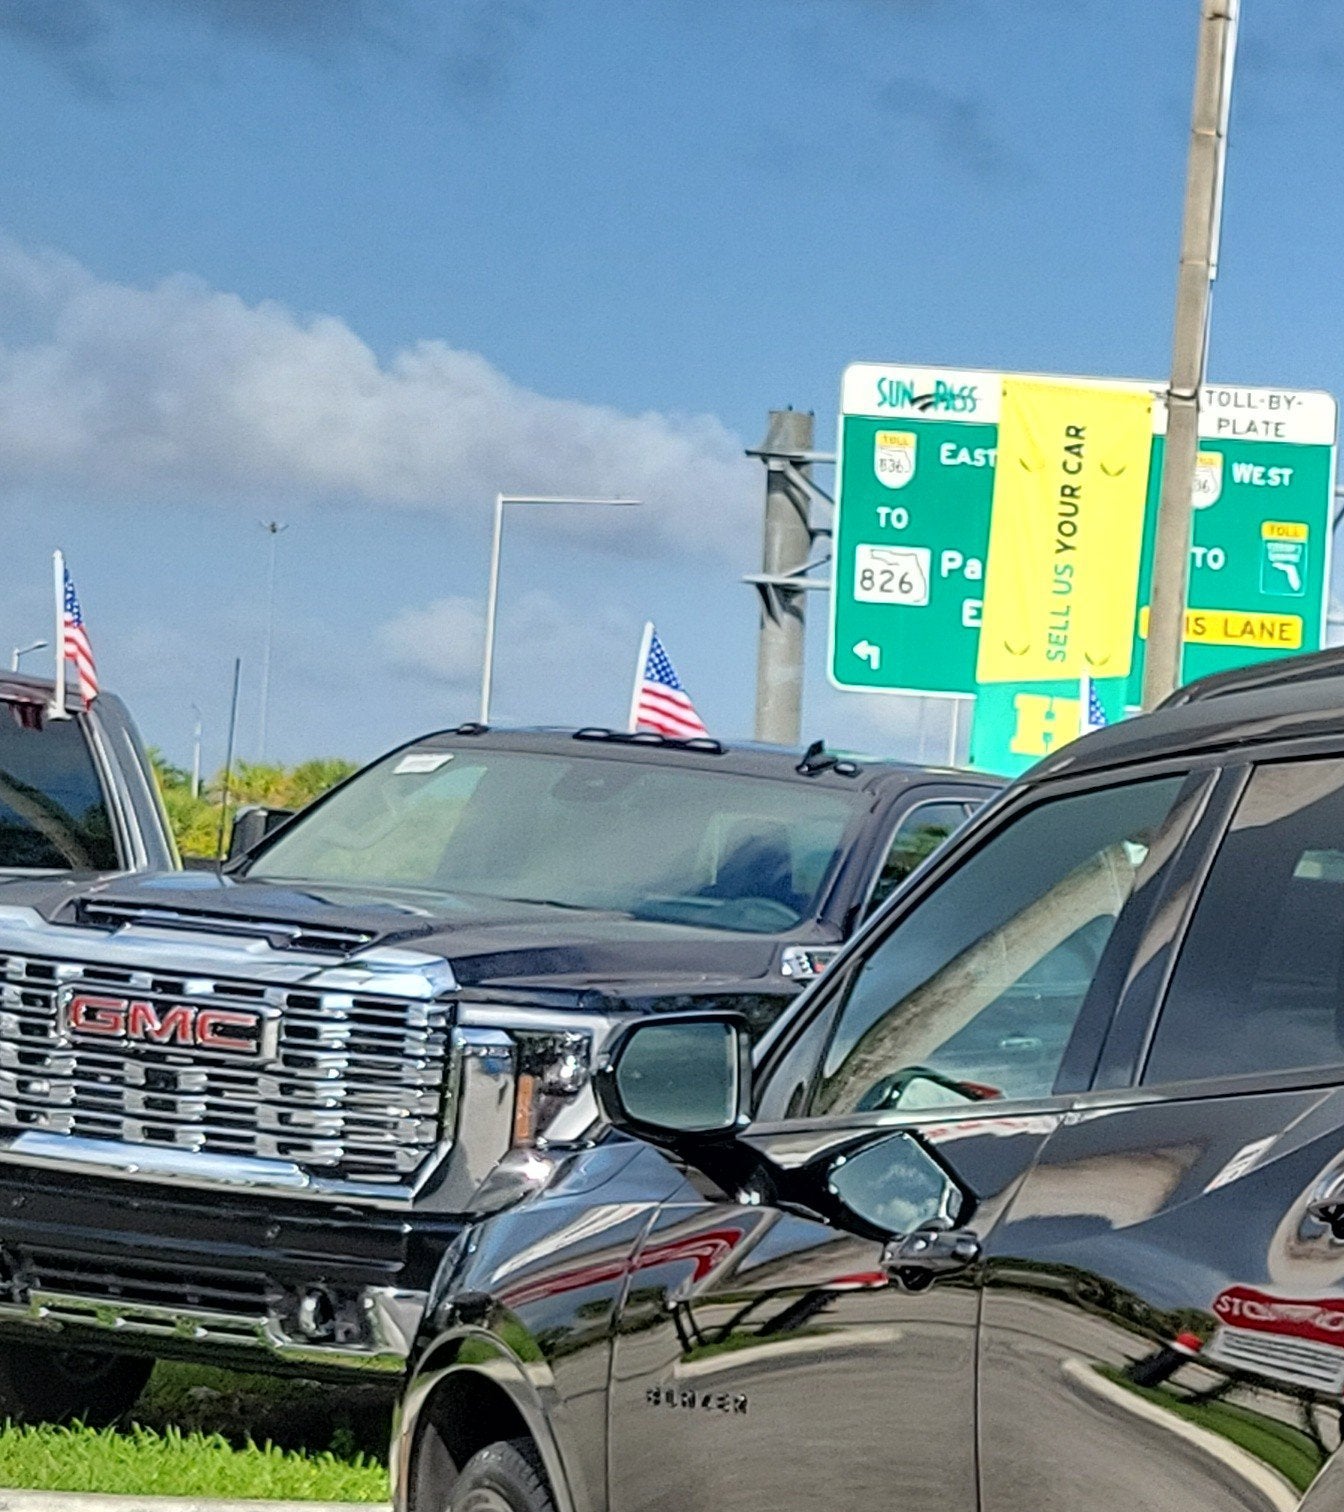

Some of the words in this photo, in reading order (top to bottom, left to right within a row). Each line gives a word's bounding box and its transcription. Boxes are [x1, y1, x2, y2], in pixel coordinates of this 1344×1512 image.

[1216, 417, 1286, 438] PLATE
[940, 442, 997, 468] EAST
[1062, 424, 1088, 476] CAR
[1231, 461, 1294, 487] WEST
[876, 506, 909, 530] TO
[1055, 483, 1083, 555] YOUR
[940, 549, 983, 581] Pa
[1190, 546, 1226, 571] TO
[860, 568, 914, 595] 826
[1052, 563, 1075, 596] US
[1046, 604, 1071, 663] SELL
[1223, 617, 1294, 642] LANE
[69, 994, 259, 1053] GMC
